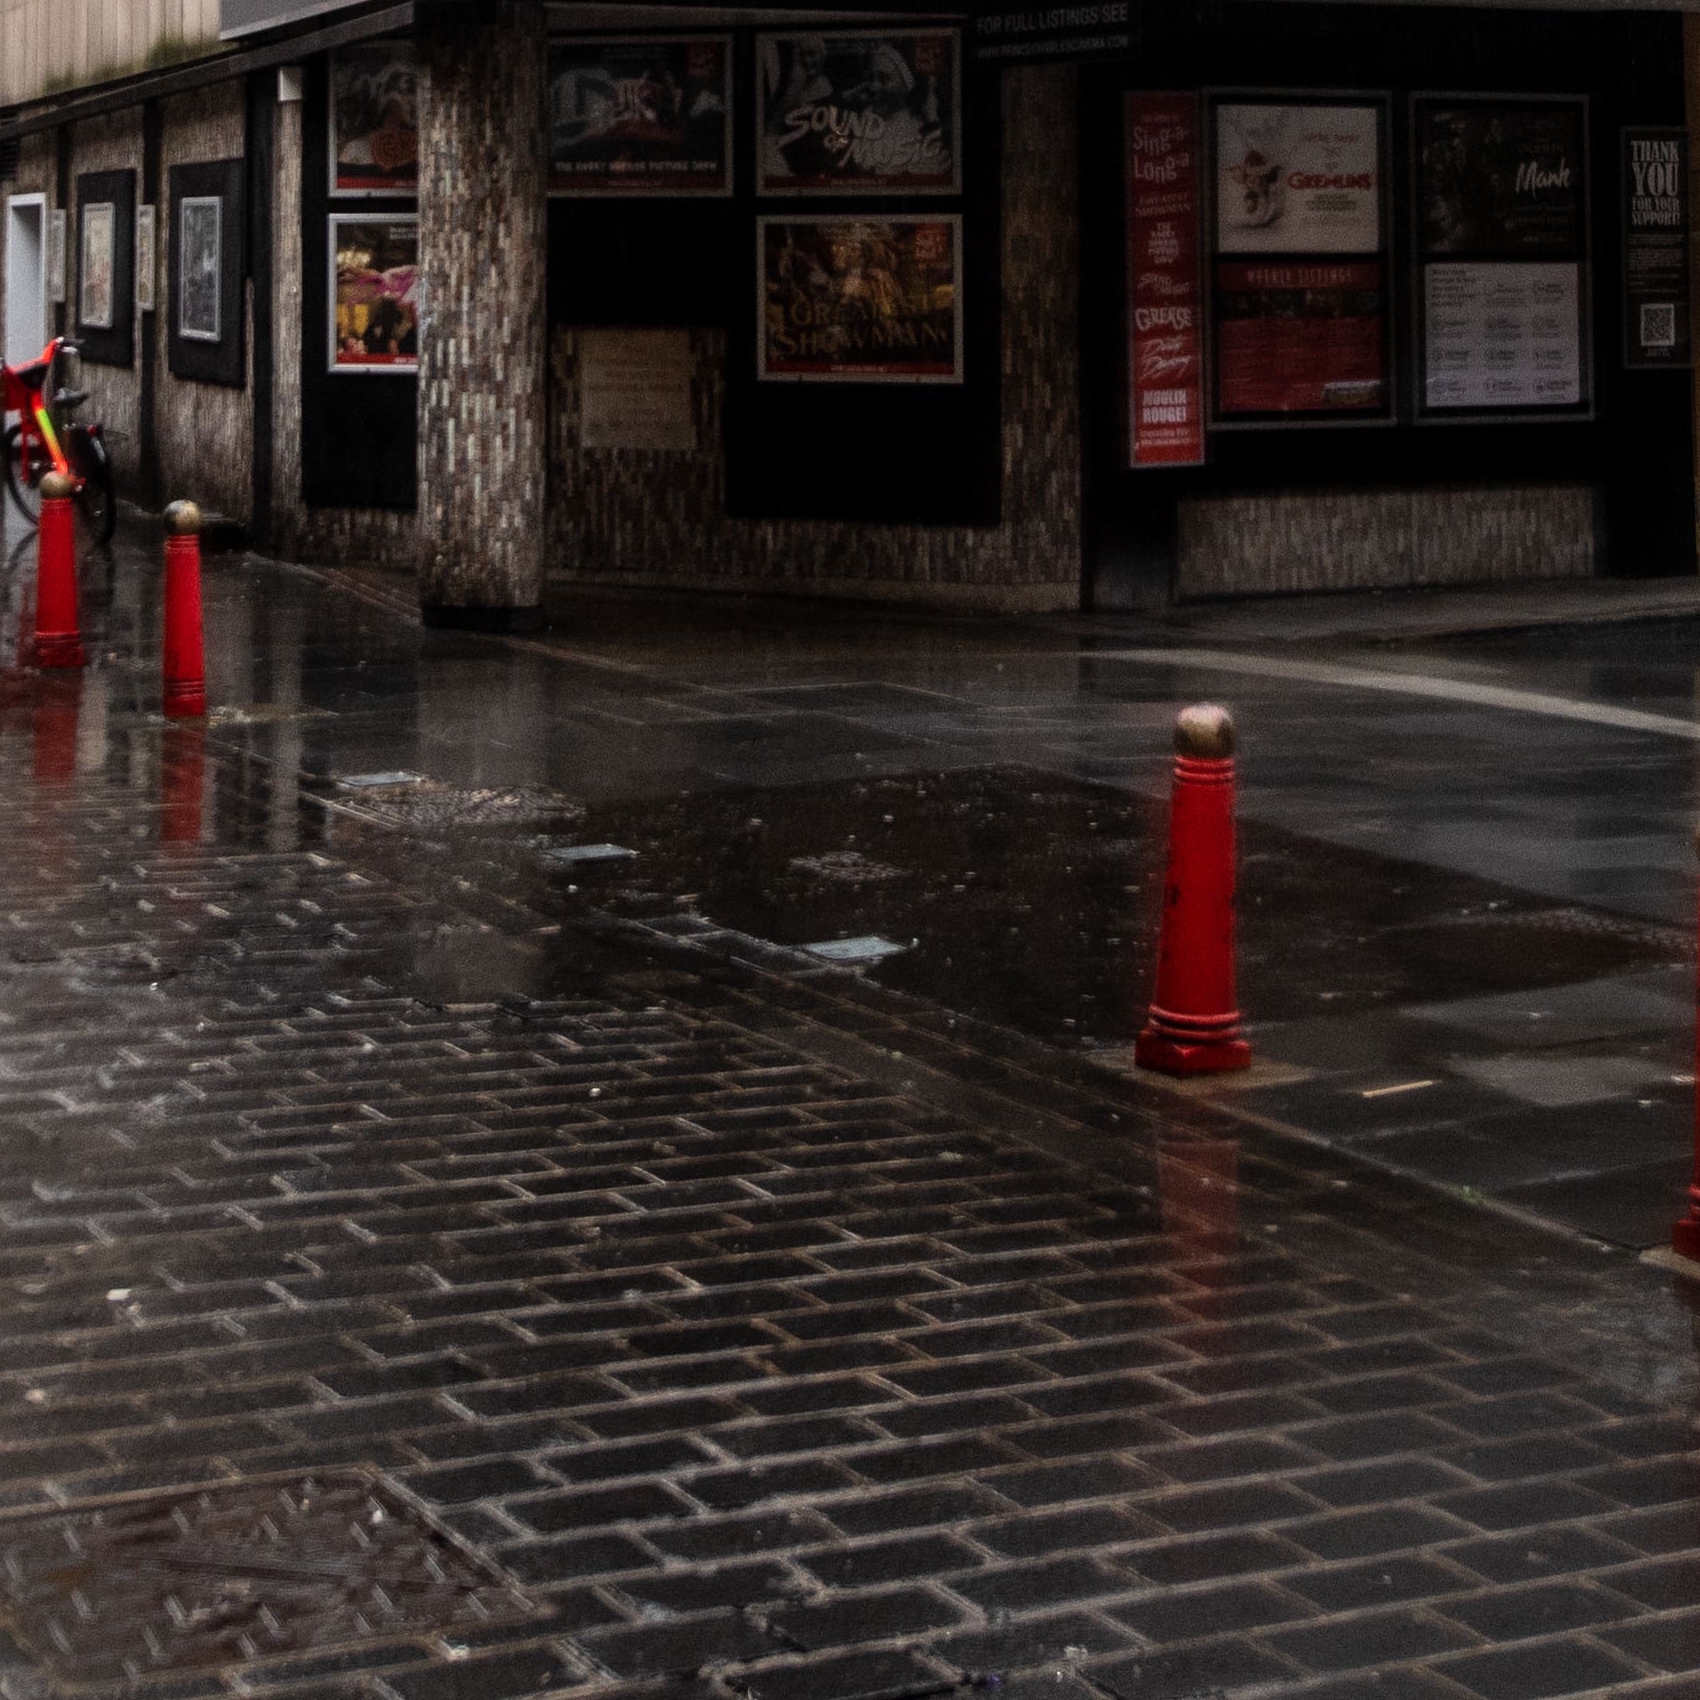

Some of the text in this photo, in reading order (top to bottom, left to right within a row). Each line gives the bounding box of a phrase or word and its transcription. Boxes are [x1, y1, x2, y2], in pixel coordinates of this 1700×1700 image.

[976, 2, 1130, 36] FOR FULL LISTINGS SEE
[1630, 139, 1680, 162] THANK
[1515, 155, 1571, 199] Mank
[1630, 161, 1679, 197] YOU
[1632, 196, 1680, 212] FOR YOUR
[1631, 211, 1681, 227] SUPPORT!
